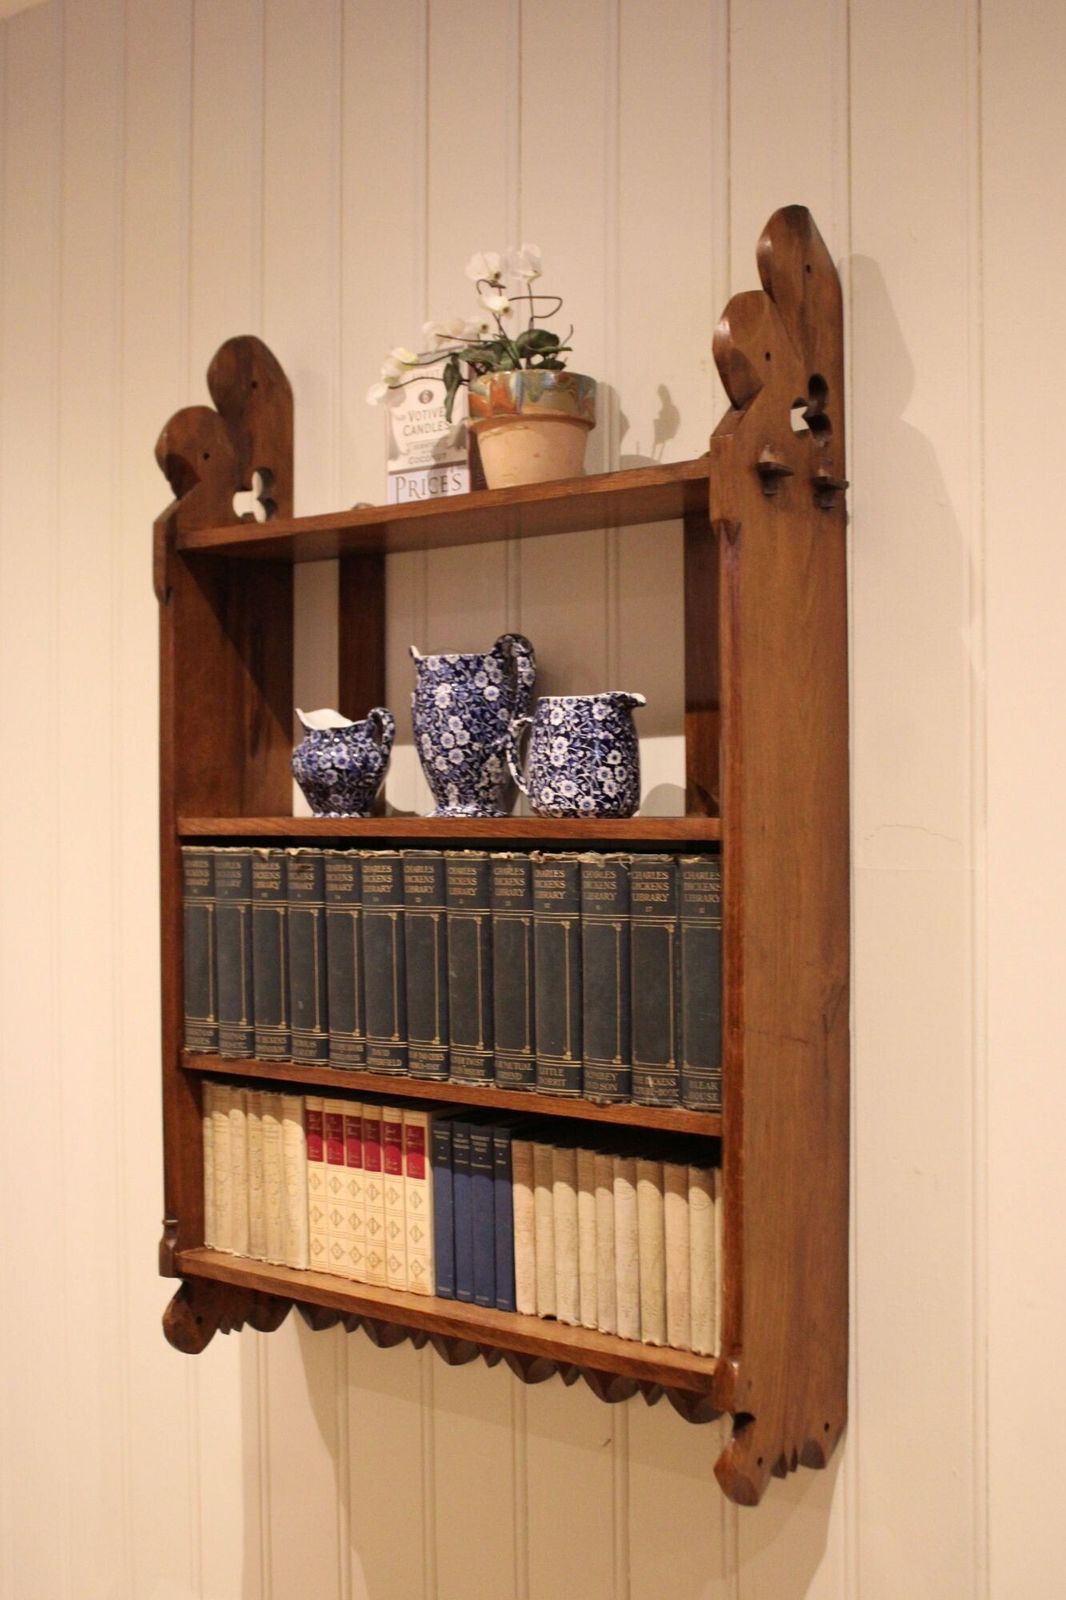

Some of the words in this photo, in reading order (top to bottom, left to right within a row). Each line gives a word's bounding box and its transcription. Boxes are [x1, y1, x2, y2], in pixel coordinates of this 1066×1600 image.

[402, 421, 450, 437] CANDLES
[631, 871, 669, 880] CHARLES
[631, 893, 669, 902] LIBRARY
